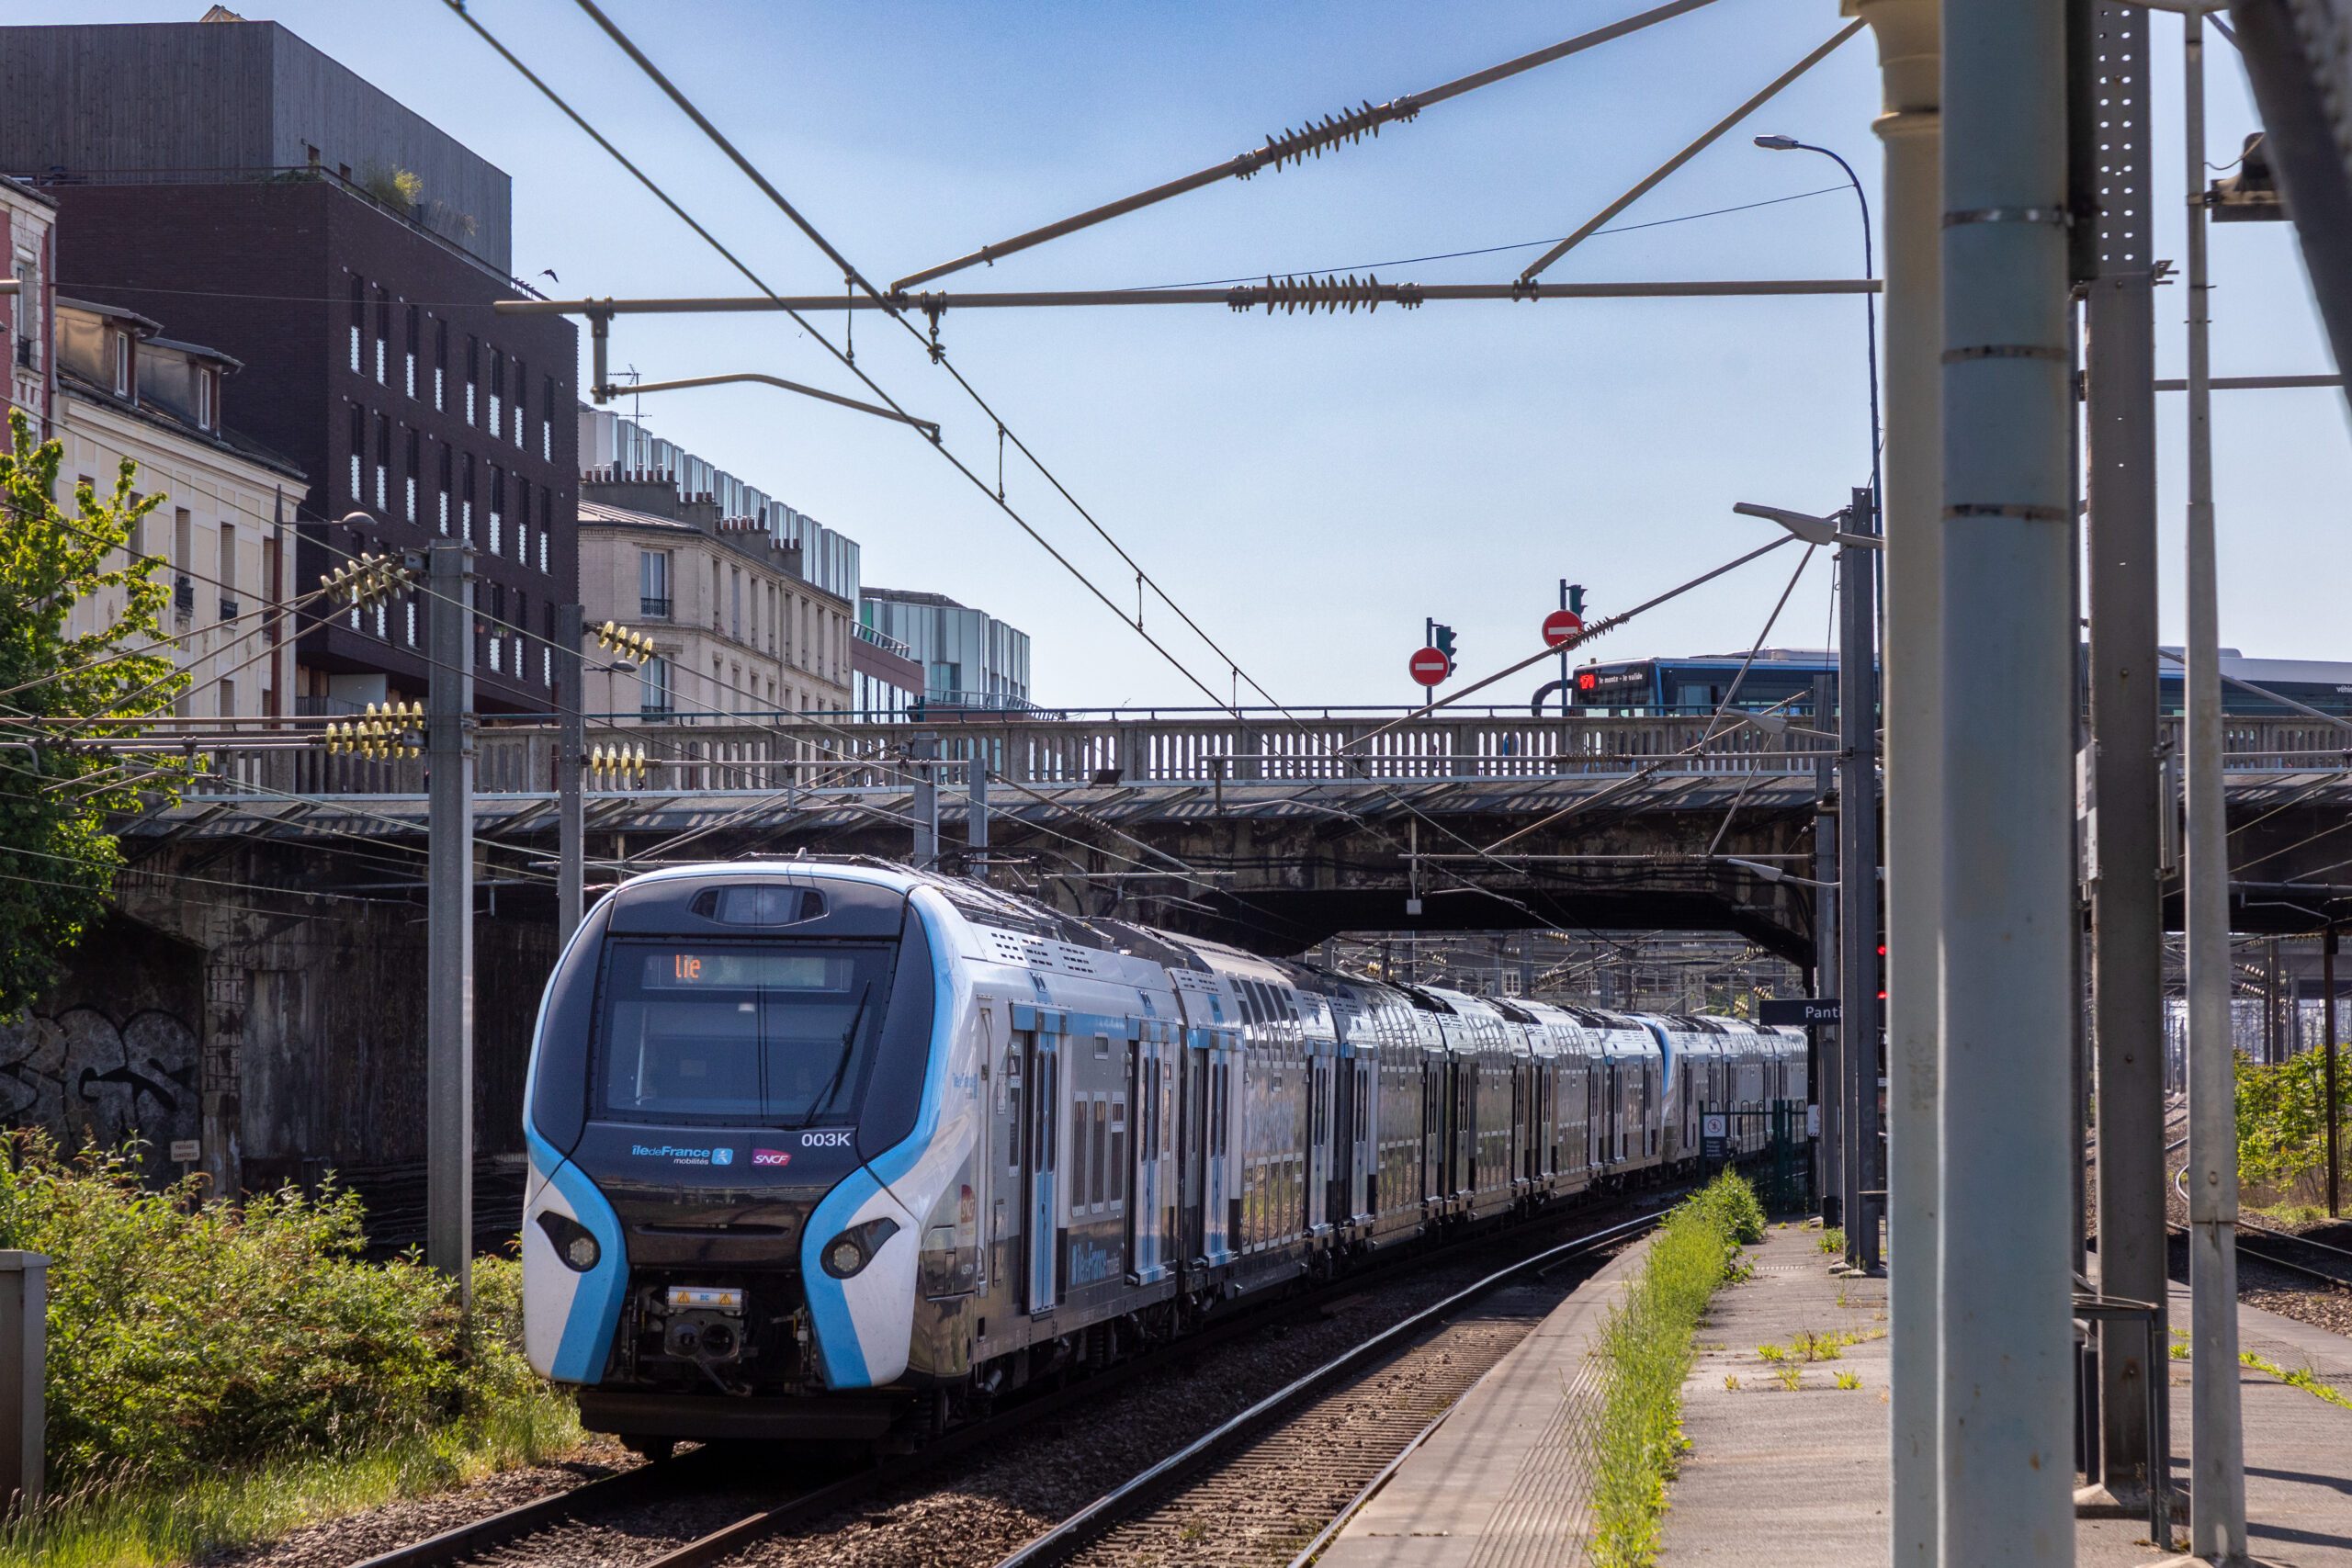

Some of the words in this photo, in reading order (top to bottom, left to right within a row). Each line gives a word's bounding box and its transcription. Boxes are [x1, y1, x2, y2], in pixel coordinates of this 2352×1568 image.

[1579, 674, 1595, 690] 170
[801, 1133, 851, 1147] 003K
[673, 1157, 709, 1166] mobilités
[753, 1155, 789, 1165] SNCF
